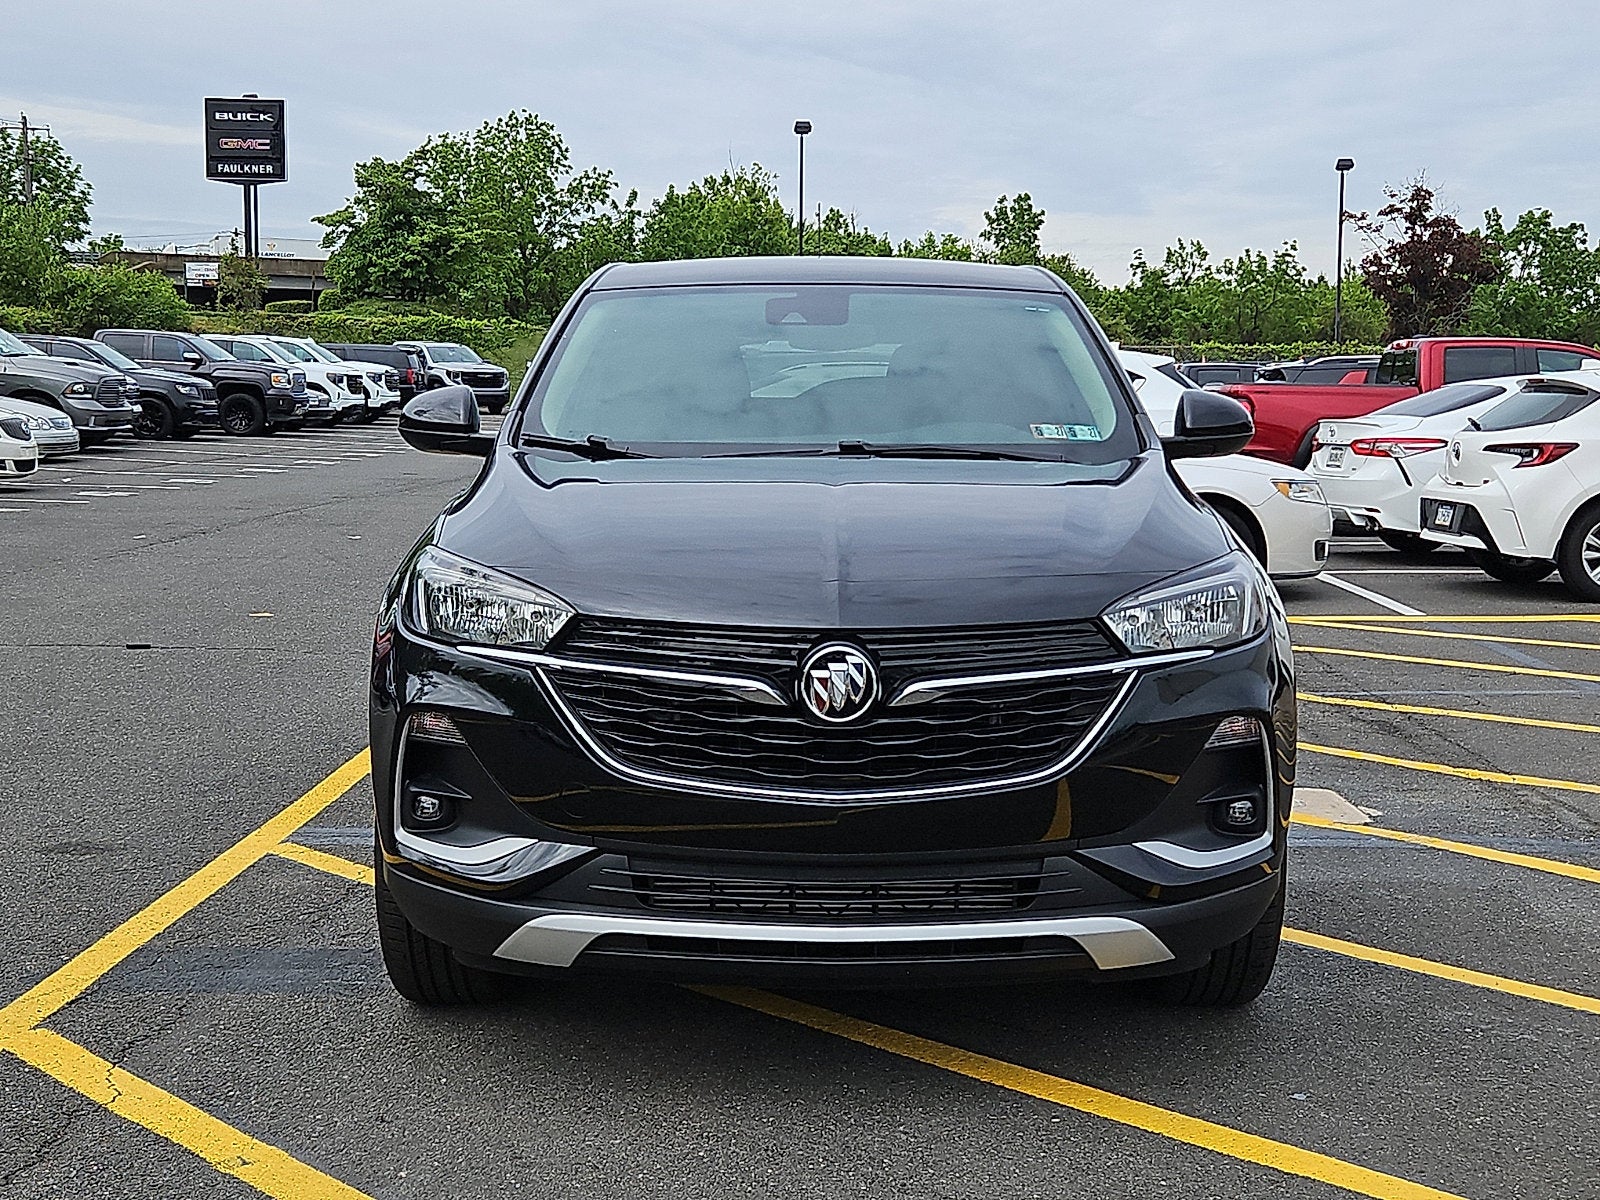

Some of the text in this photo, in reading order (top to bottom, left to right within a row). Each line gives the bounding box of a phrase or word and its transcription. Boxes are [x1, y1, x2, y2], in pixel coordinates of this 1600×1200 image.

[214, 111, 275, 121] BUICK
[219, 138, 271, 150] GMC
[217, 163, 273, 174] FAULKNER
